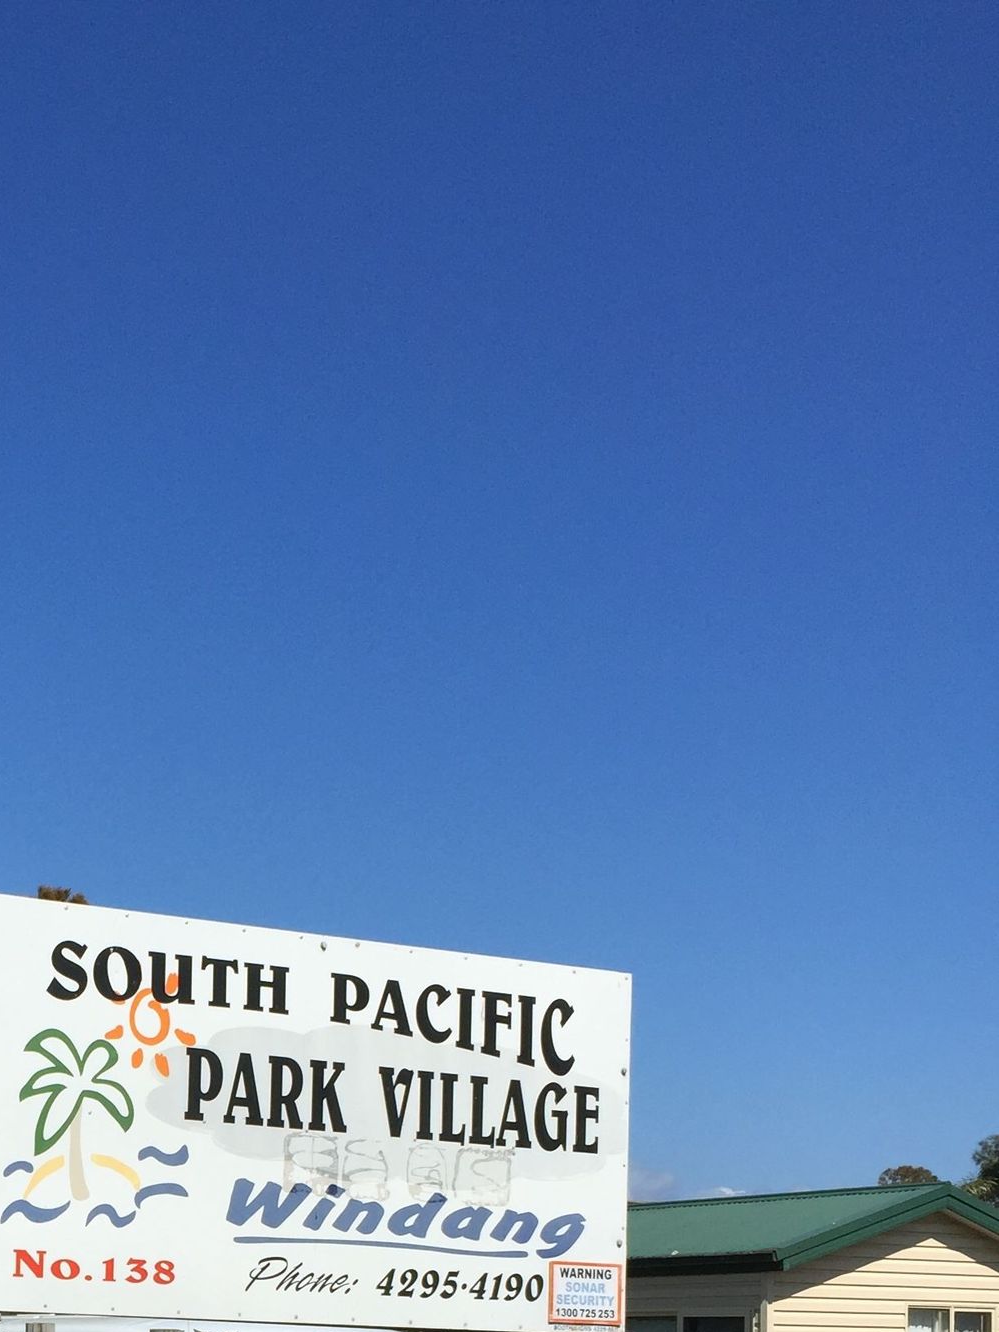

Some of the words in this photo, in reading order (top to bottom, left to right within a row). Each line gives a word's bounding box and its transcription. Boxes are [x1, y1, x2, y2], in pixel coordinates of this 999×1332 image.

[47, 941, 289, 1014] SOUTH
[330, 973, 574, 1076] PACIFIC
[184, 1048, 346, 1133] PARK
[377, 1067, 599, 1154] VILLAGE
[226, 1179, 585, 1259] Windang
[245, 1257, 360, 1294] Phone:
[560, 1268, 612, 1280] WARNING
[565, 1281, 606, 1293] SONAR
[556, 1294, 615, 1306] SECURITY
[556, 1308, 578, 1317] 1300
[580, 1309, 597, 1318] 725
[598, 1309, 615, 1319] 253
